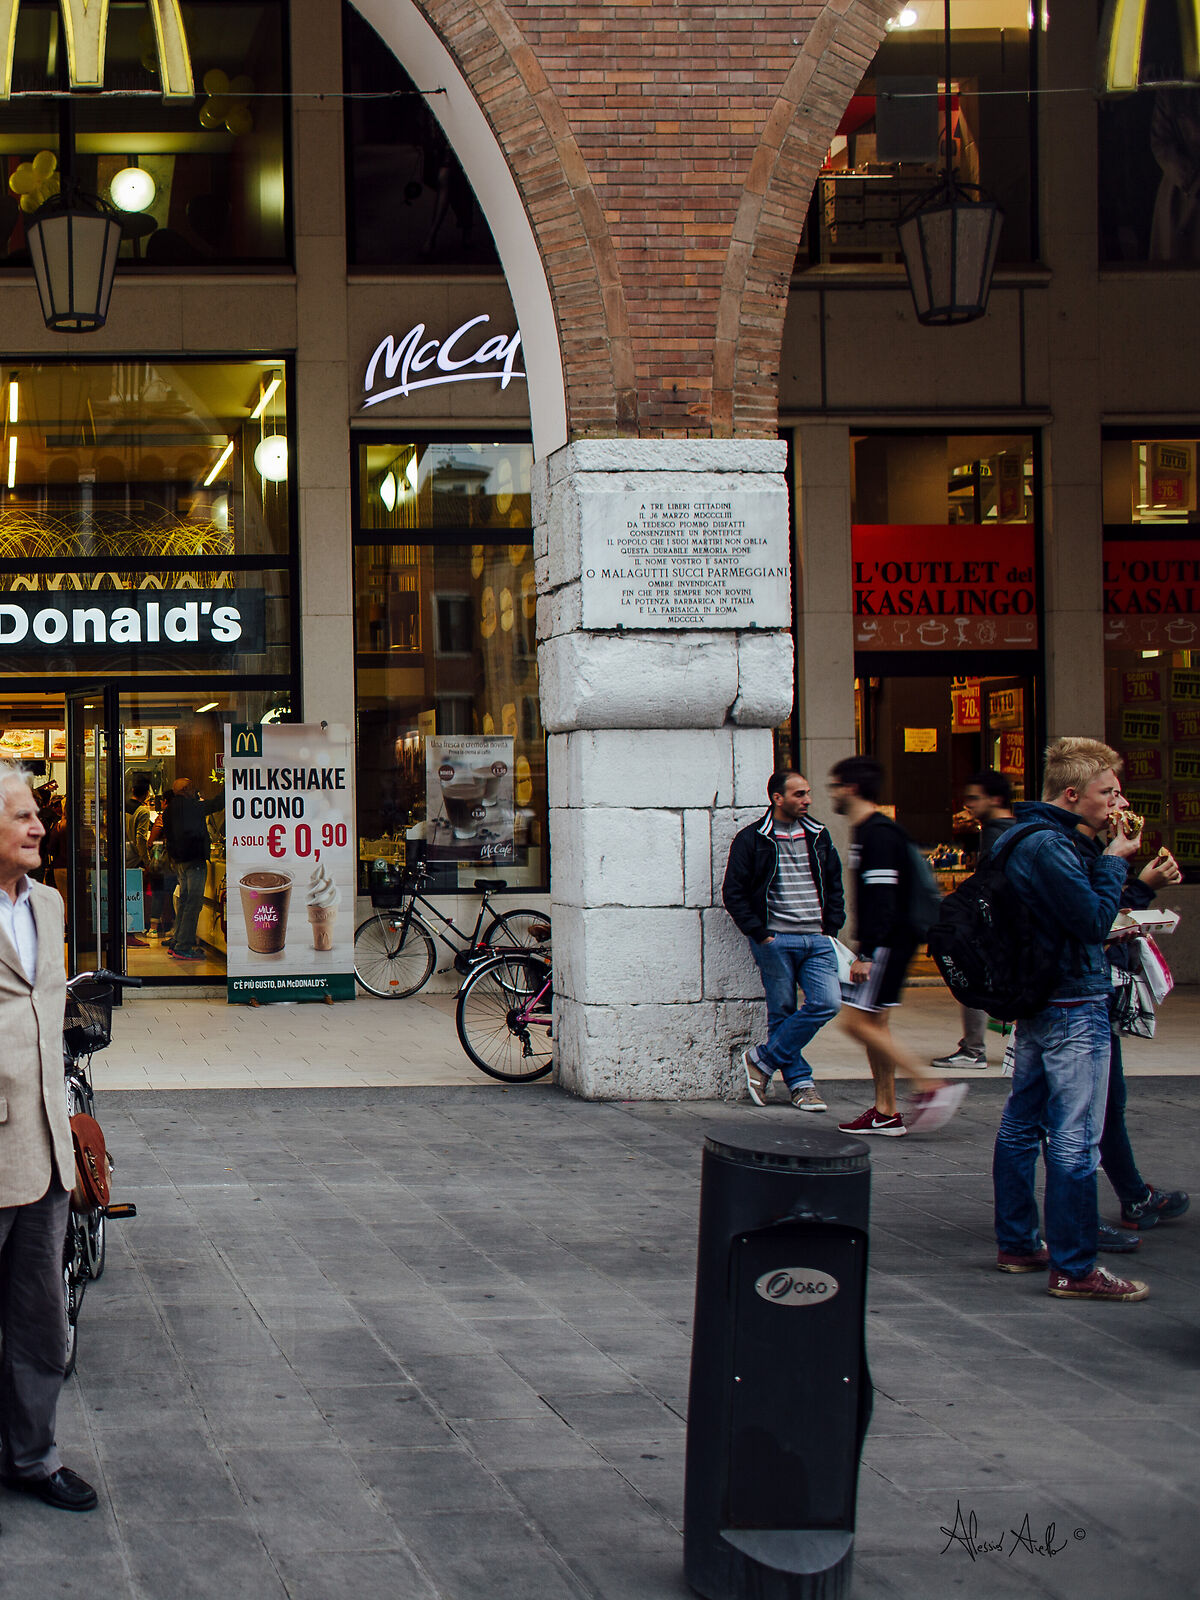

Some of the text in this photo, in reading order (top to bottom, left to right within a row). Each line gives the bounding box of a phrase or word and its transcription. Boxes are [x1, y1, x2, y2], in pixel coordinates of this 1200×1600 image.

[620, 547, 649, 555] QUESTA
[586, 568, 788, 578] O MALAGUTTI SUCCI PARMEGGIANI
[855, 561, 1033, 584] L'OUTLET del
[855, 589, 1035, 616] KASALINGO
[639, 606, 644, 614] E
[1125, 721, 1159, 735] TUTTO
[232, 768, 346, 791] MILKSHAKE
[232, 796, 304, 819] O CONO
[1130, 801, 1160, 815] UTTO
[232, 836, 239, 846] A
[241, 835, 264, 846] SOLO
[253, 914, 279, 922] SHAKE
[255, 980, 276, 990] GUSTO,
[277, 980, 286, 989] DA
[793, 1282, 827, 1294] O&O
